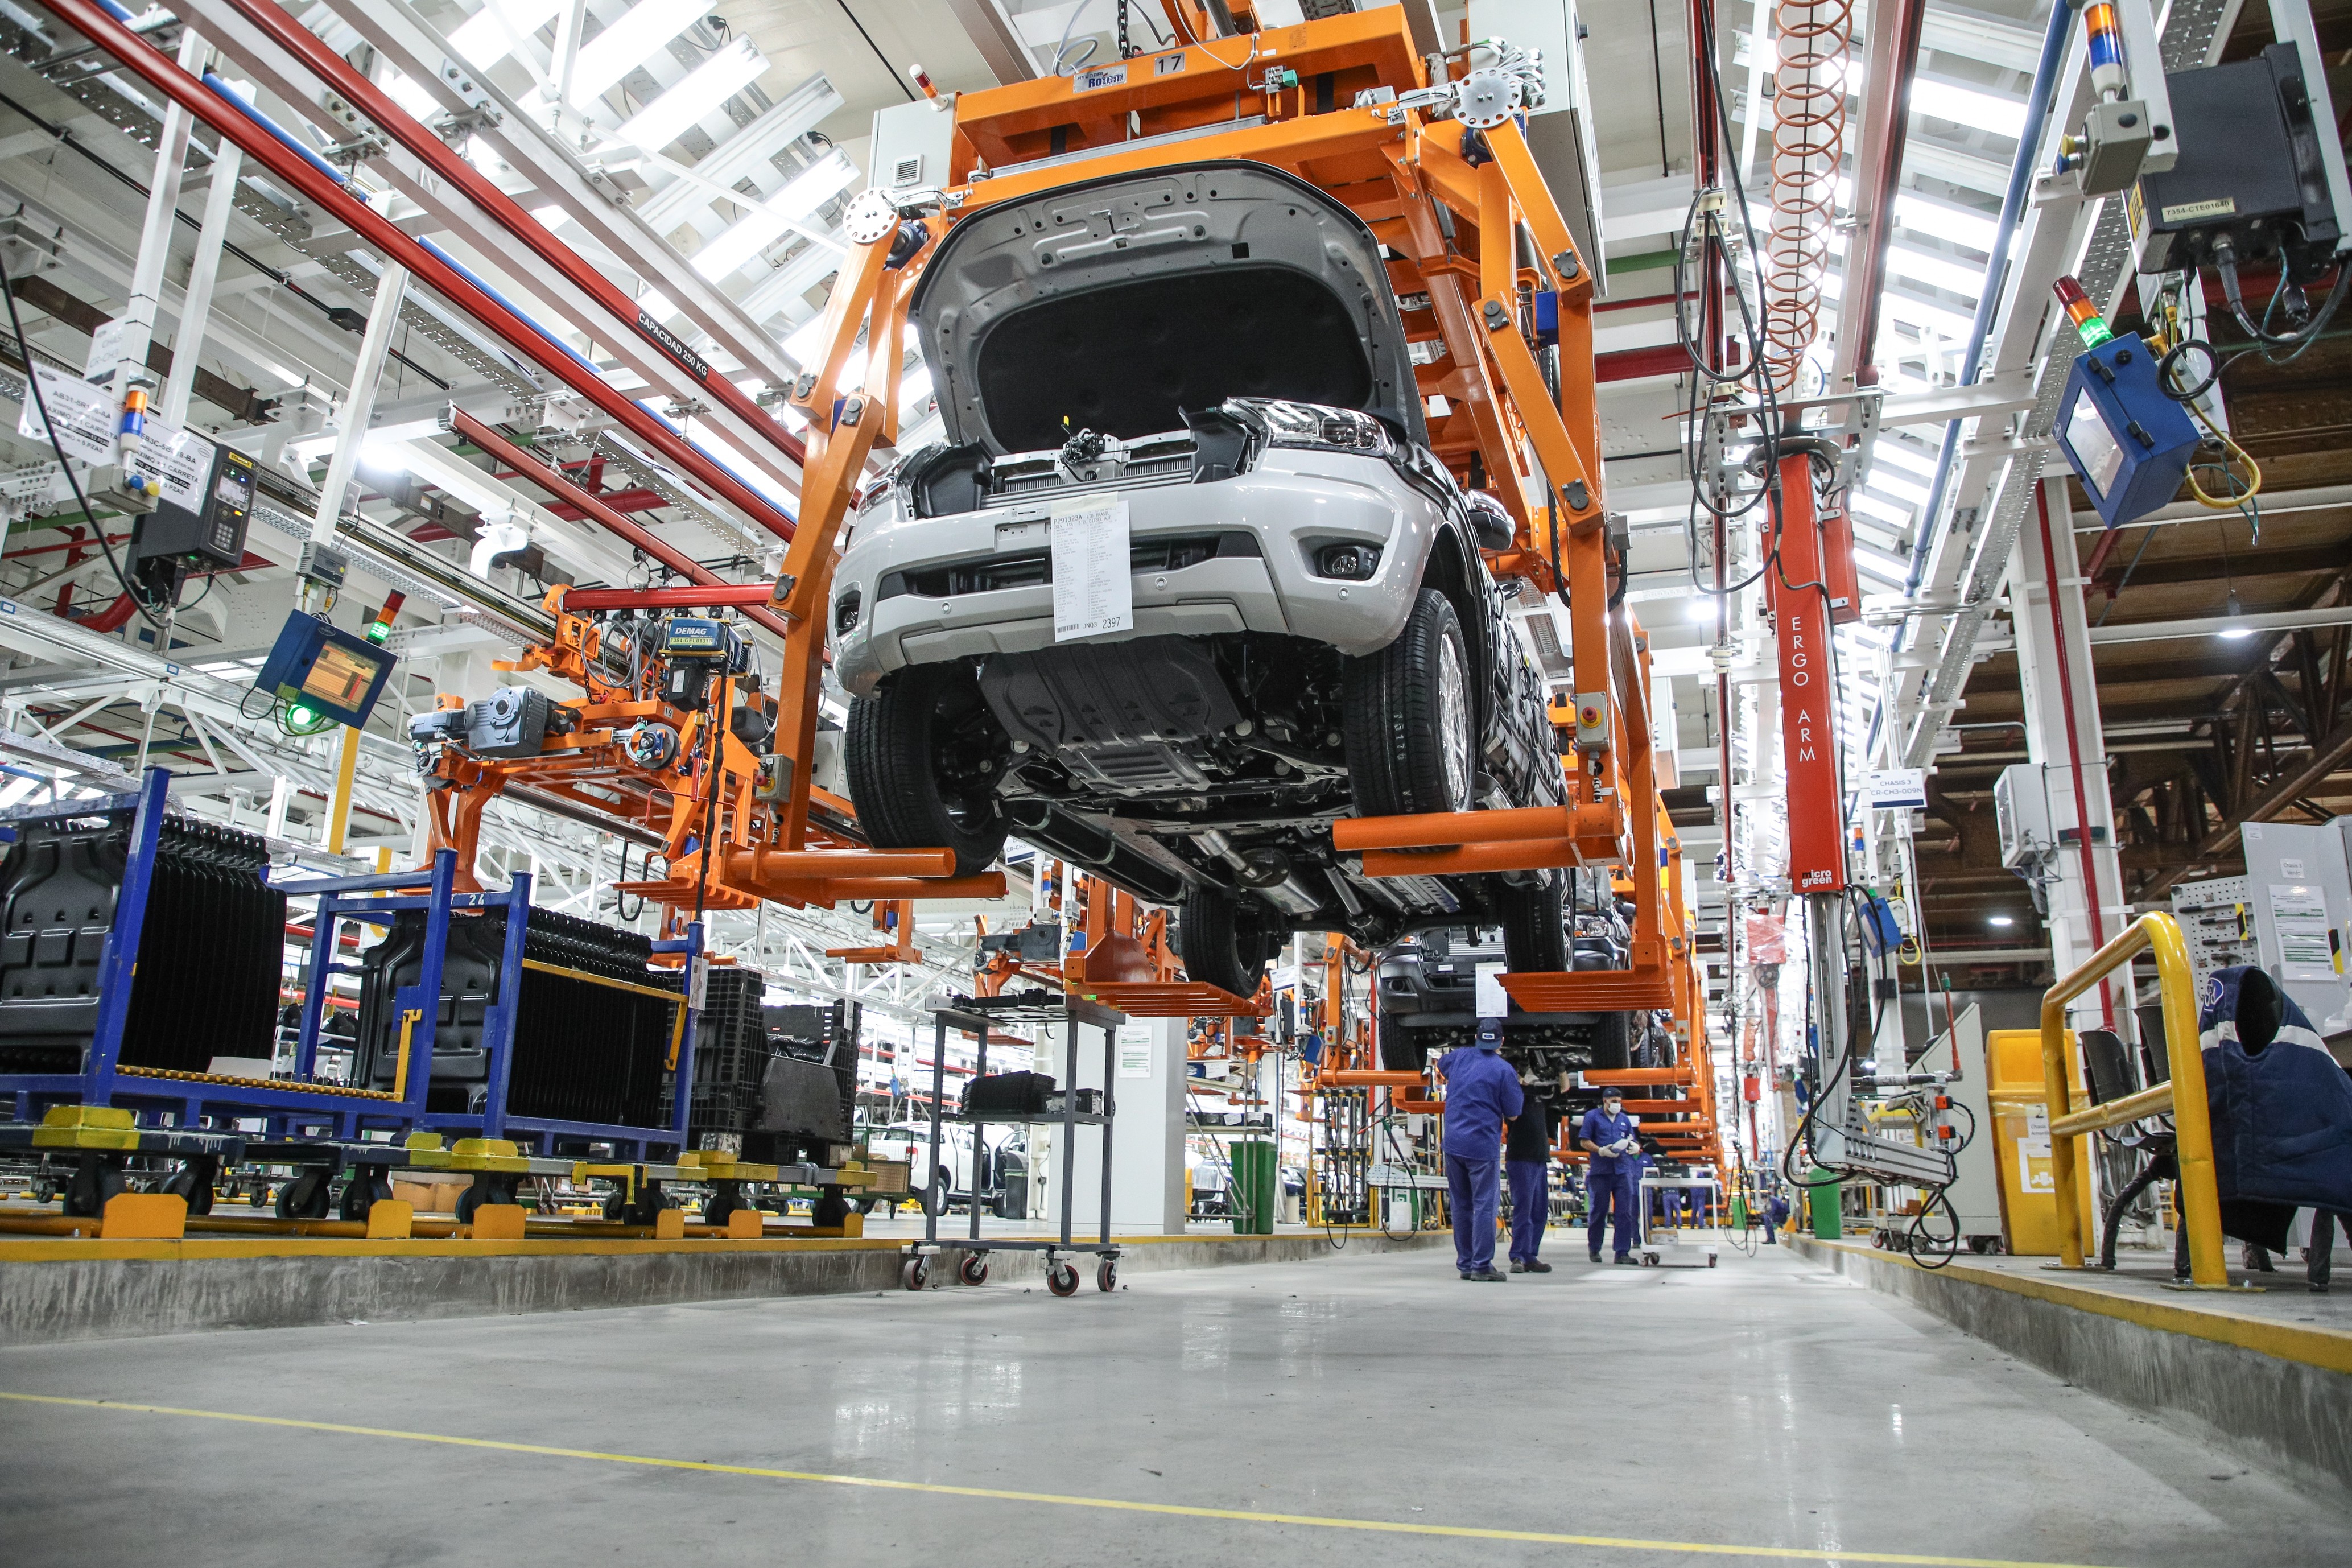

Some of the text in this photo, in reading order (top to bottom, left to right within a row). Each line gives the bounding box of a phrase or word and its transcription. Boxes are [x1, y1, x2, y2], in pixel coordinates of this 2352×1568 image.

[1158, 55, 1182, 73] 17
[1077, 72, 1103, 80] HYUNDAI
[638, 313, 707, 376] CAPACIDAD 250 KG
[85, 422, 118, 440] CARRETA
[87, 442, 104, 453] PZAS
[168, 465, 199, 483] CARRETA
[168, 484, 184, 496] PZAS
[1053, 514, 1083, 525] P291323A
[1103, 617, 1120, 629] 2397
[1791, 616, 1815, 762] ERGO ARM
[665, 707, 672, 717] 19
[1871, 787, 1923, 796] CR-CH3-009N
[1006, 843, 1028, 852] CR-CH3-
[1802, 869, 1832, 878] micro
[1802, 877, 1833, 888] green
